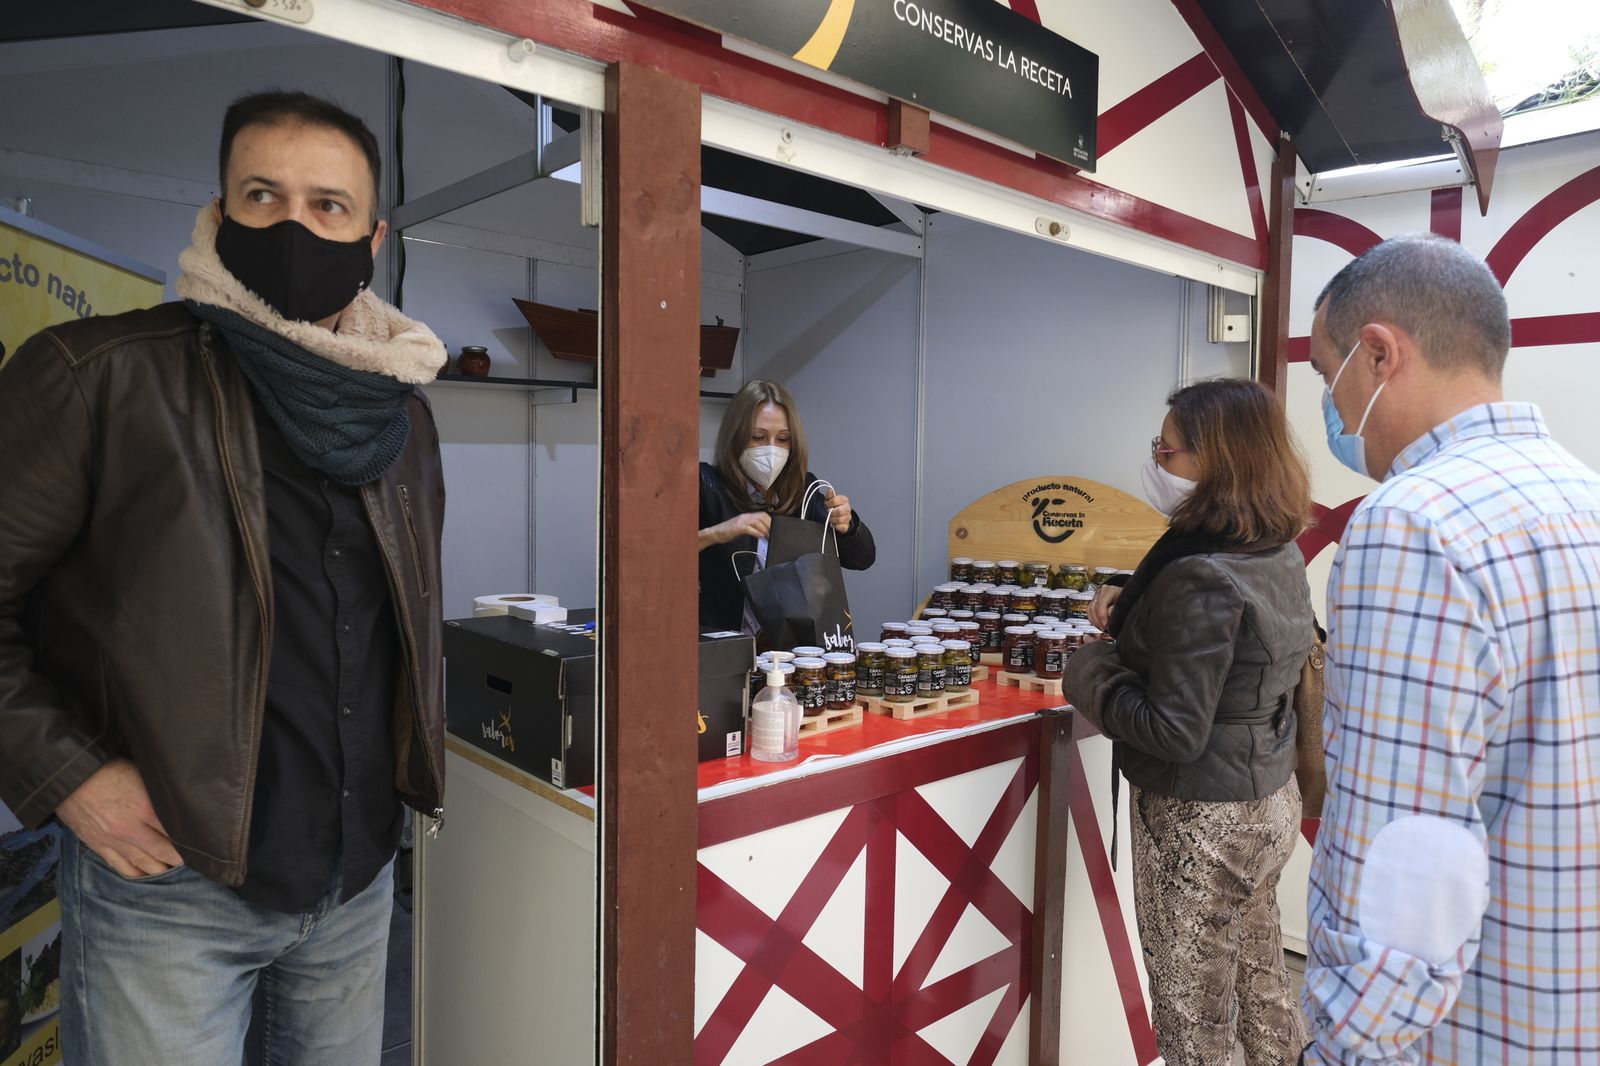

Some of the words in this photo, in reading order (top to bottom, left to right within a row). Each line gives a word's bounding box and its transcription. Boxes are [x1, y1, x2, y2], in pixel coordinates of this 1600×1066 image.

[893, 0, 994, 62] CONSERVAS
[998, 44, 1017, 73] LA
[1021, 56, 1073, 99] RECETA
[1022, 482, 1061, 502] producto
[1062, 484, 1095, 503] natural
[1042, 510, 1077, 518] Conservas
[1042, 516, 1083, 528] Receta
